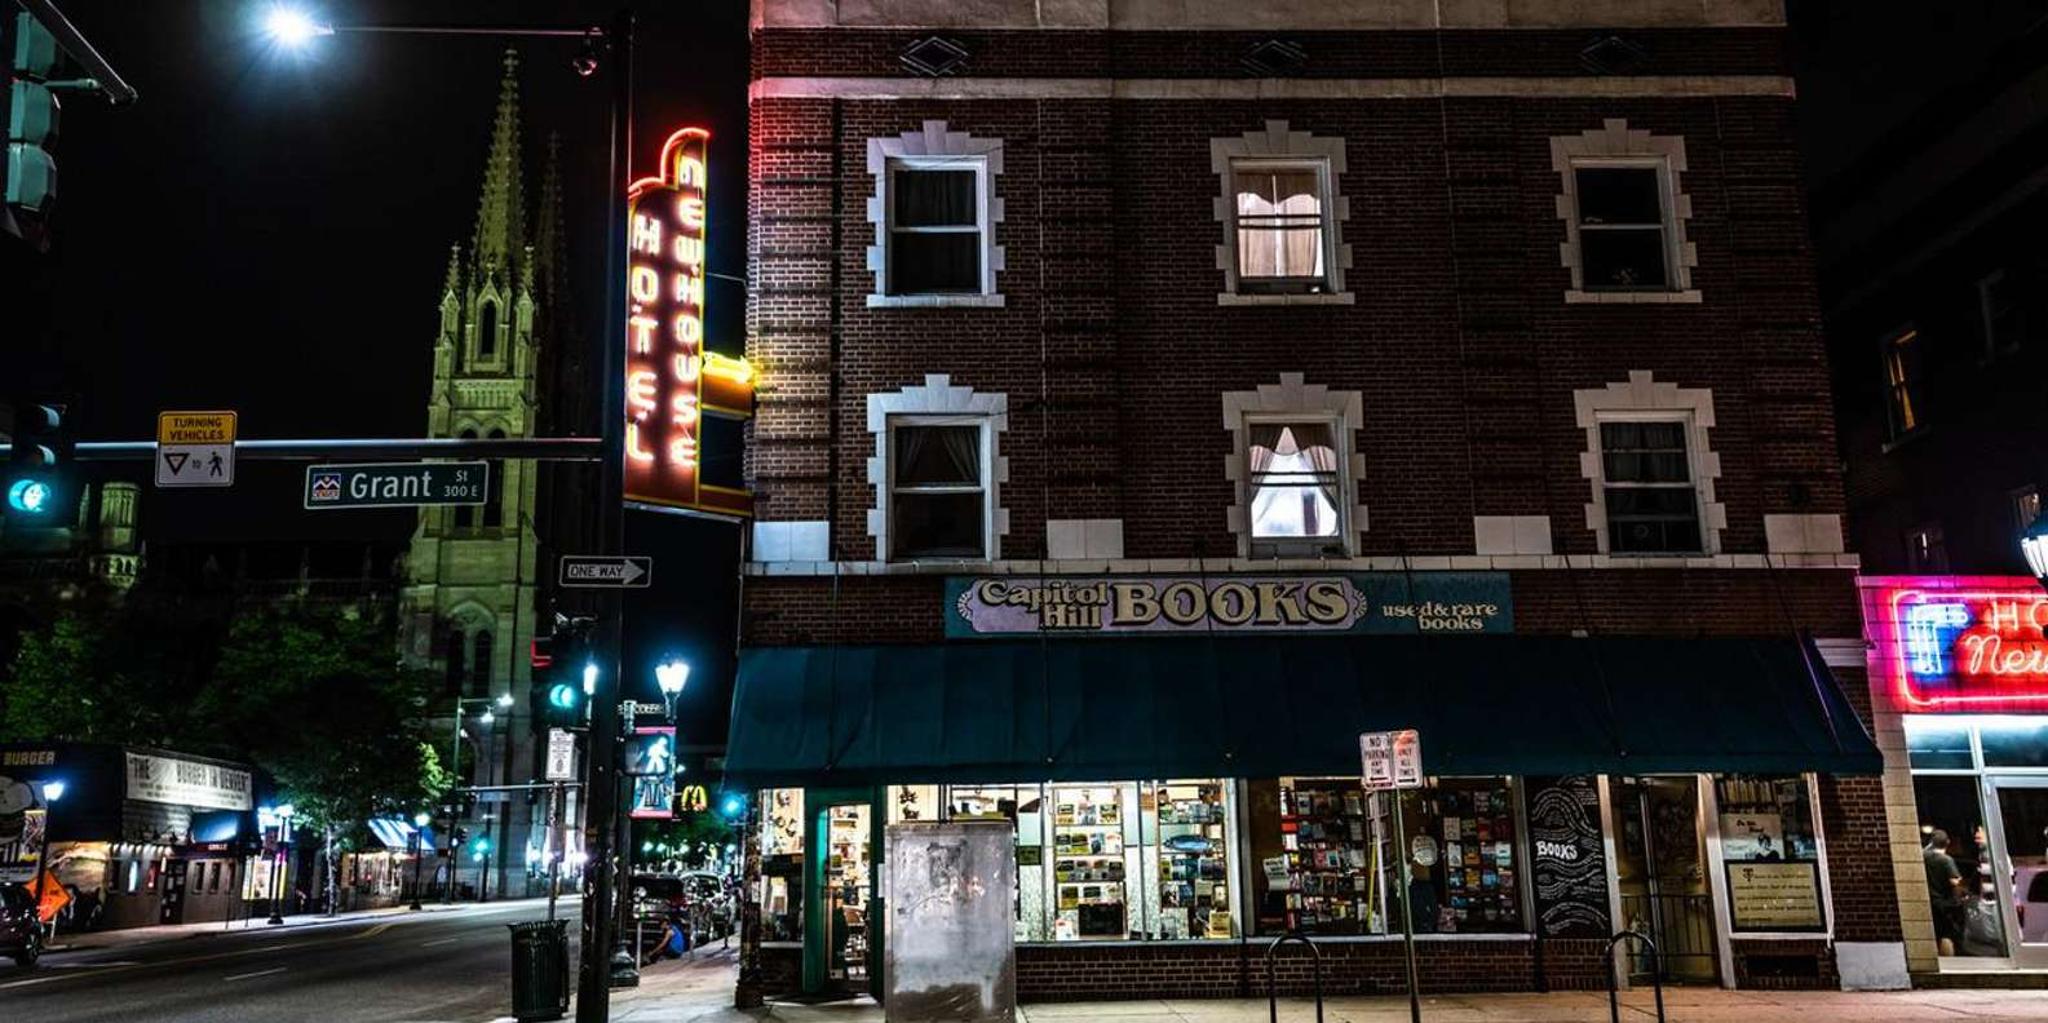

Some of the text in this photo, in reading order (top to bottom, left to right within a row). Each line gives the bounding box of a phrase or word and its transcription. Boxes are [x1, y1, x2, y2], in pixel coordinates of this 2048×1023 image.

[627, 213, 661, 461] HOTEL
[173, 417, 223, 427] TURNING
[169, 429, 224, 440] VEHICLES
[455, 469, 468, 482] St
[350, 470, 433, 499] Grant
[443, 485, 478, 497] 300 E
[570, 565, 623, 577] ONE WAY
[979, 578, 1109, 613] Capitol
[1110, 581, 1350, 627] BOOKS
[1041, 603, 1102, 629] Hill
[1418, 615, 1484, 630] books
[1369, 737, 1381, 747] NO
[3, 751, 55, 766] BURGER
[176, 763, 207, 786] BURGER
[209, 768, 218, 788] IN
[1535, 840, 1578, 860] BOOKS
